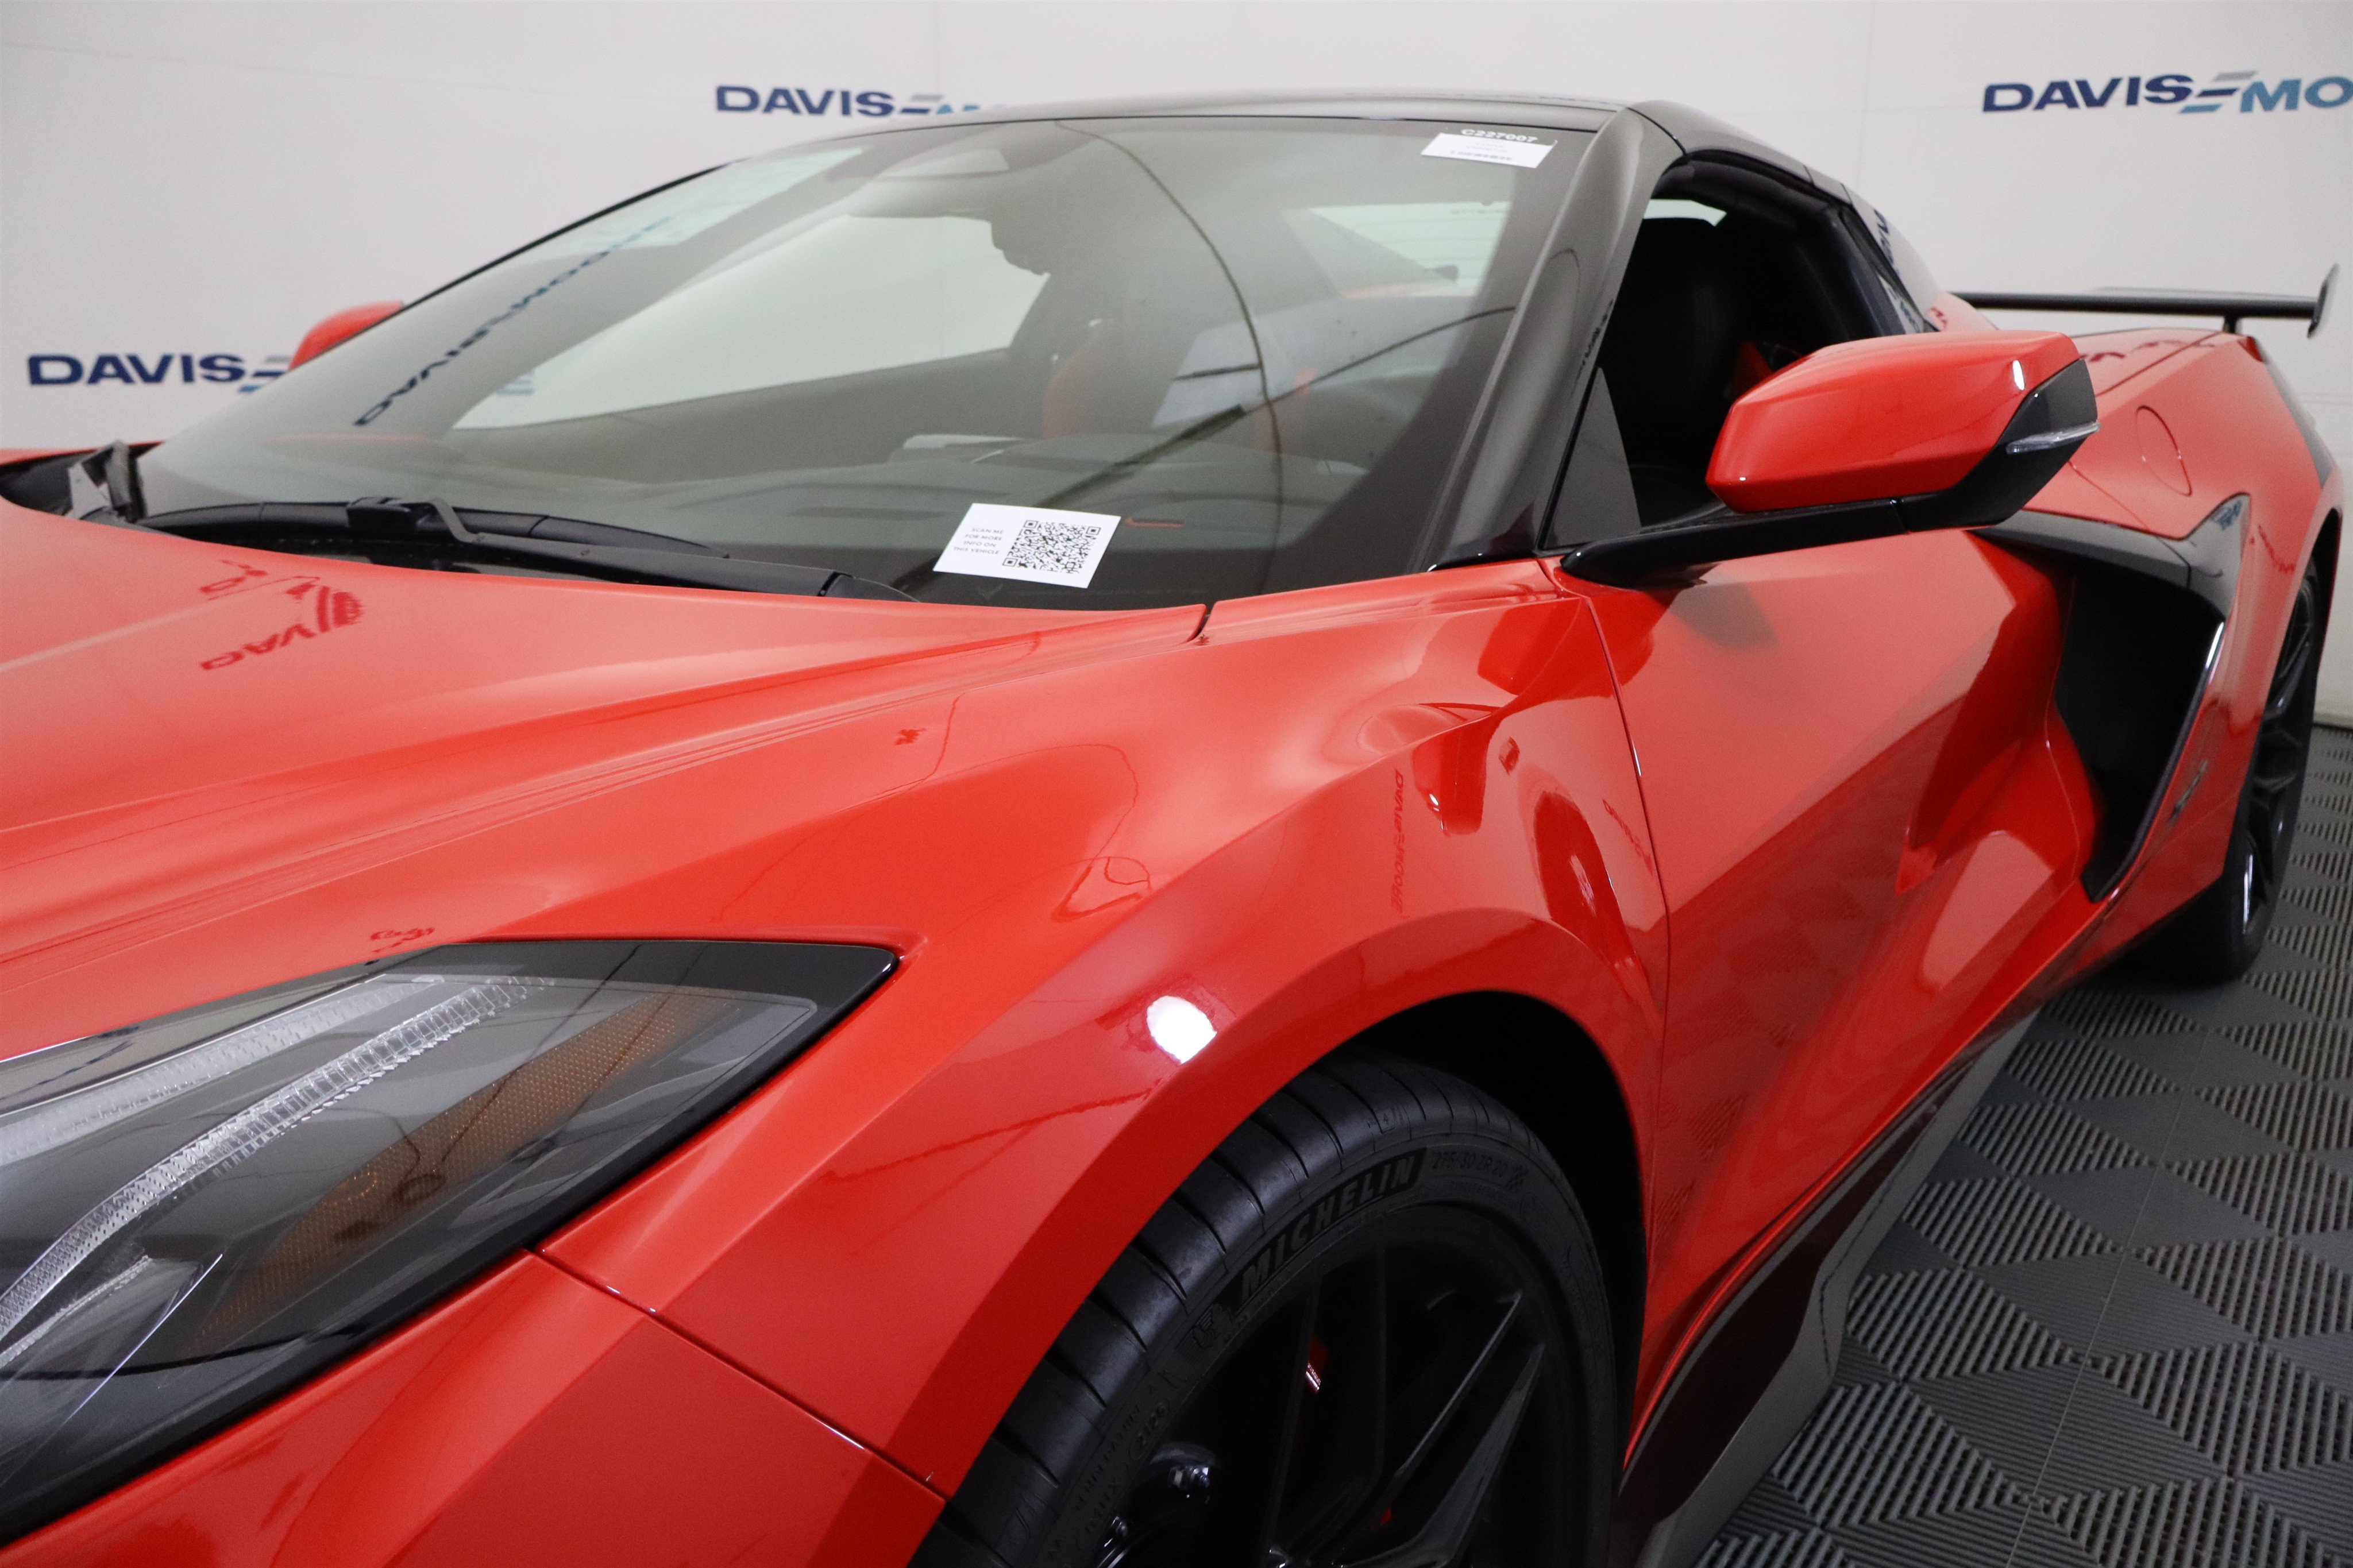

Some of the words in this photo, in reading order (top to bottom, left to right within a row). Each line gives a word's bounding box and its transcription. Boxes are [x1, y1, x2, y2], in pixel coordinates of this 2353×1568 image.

[716, 85, 895, 117] DAVIS
[1982, 74, 2194, 112] DAVIS
[27, 353, 246, 386] DAVIS
[1240, 1154, 1417, 1303] MICHELIN
